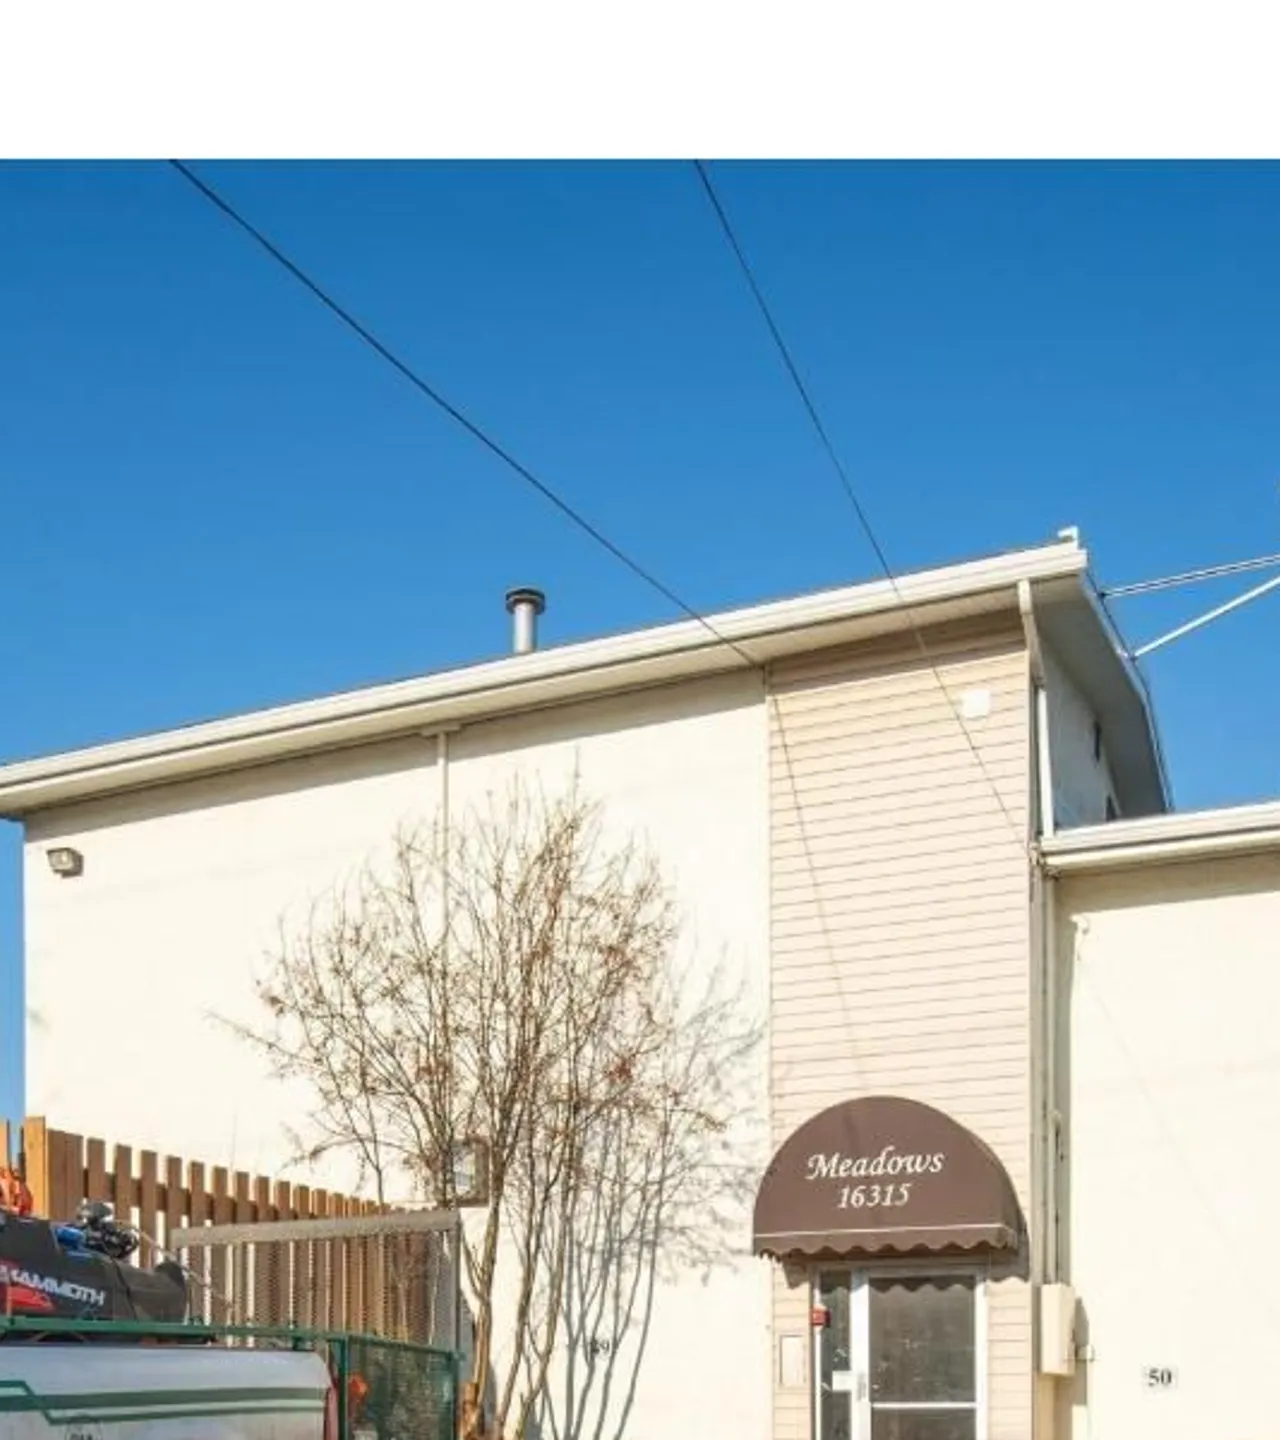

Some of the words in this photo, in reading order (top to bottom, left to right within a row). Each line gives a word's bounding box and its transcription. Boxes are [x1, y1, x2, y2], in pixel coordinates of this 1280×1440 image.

[805, 1146, 946, 1180] Meadows
[837, 1182, 912, 1209] 16315
[1148, 1367, 1172, 1387] 50
